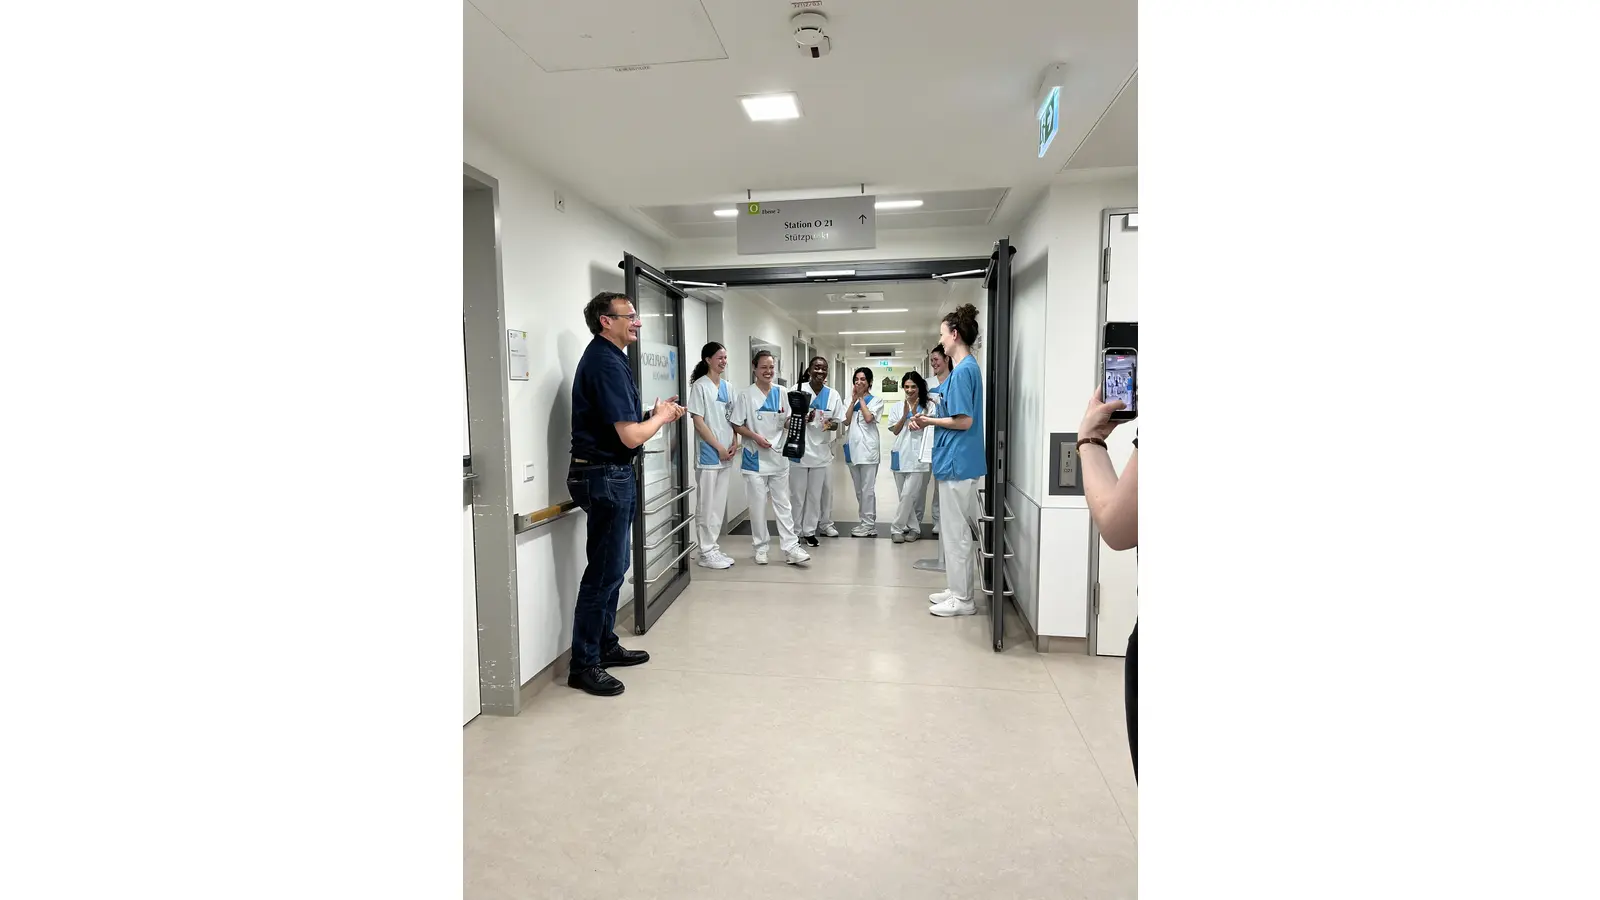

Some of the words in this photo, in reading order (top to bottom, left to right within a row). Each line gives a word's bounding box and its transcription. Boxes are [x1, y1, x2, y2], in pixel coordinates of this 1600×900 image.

[784, 220, 812, 229] Station
[814, 219, 822, 227] O
[824, 219, 833, 227] 21
[784, 232, 829, 242] Stützpukt
